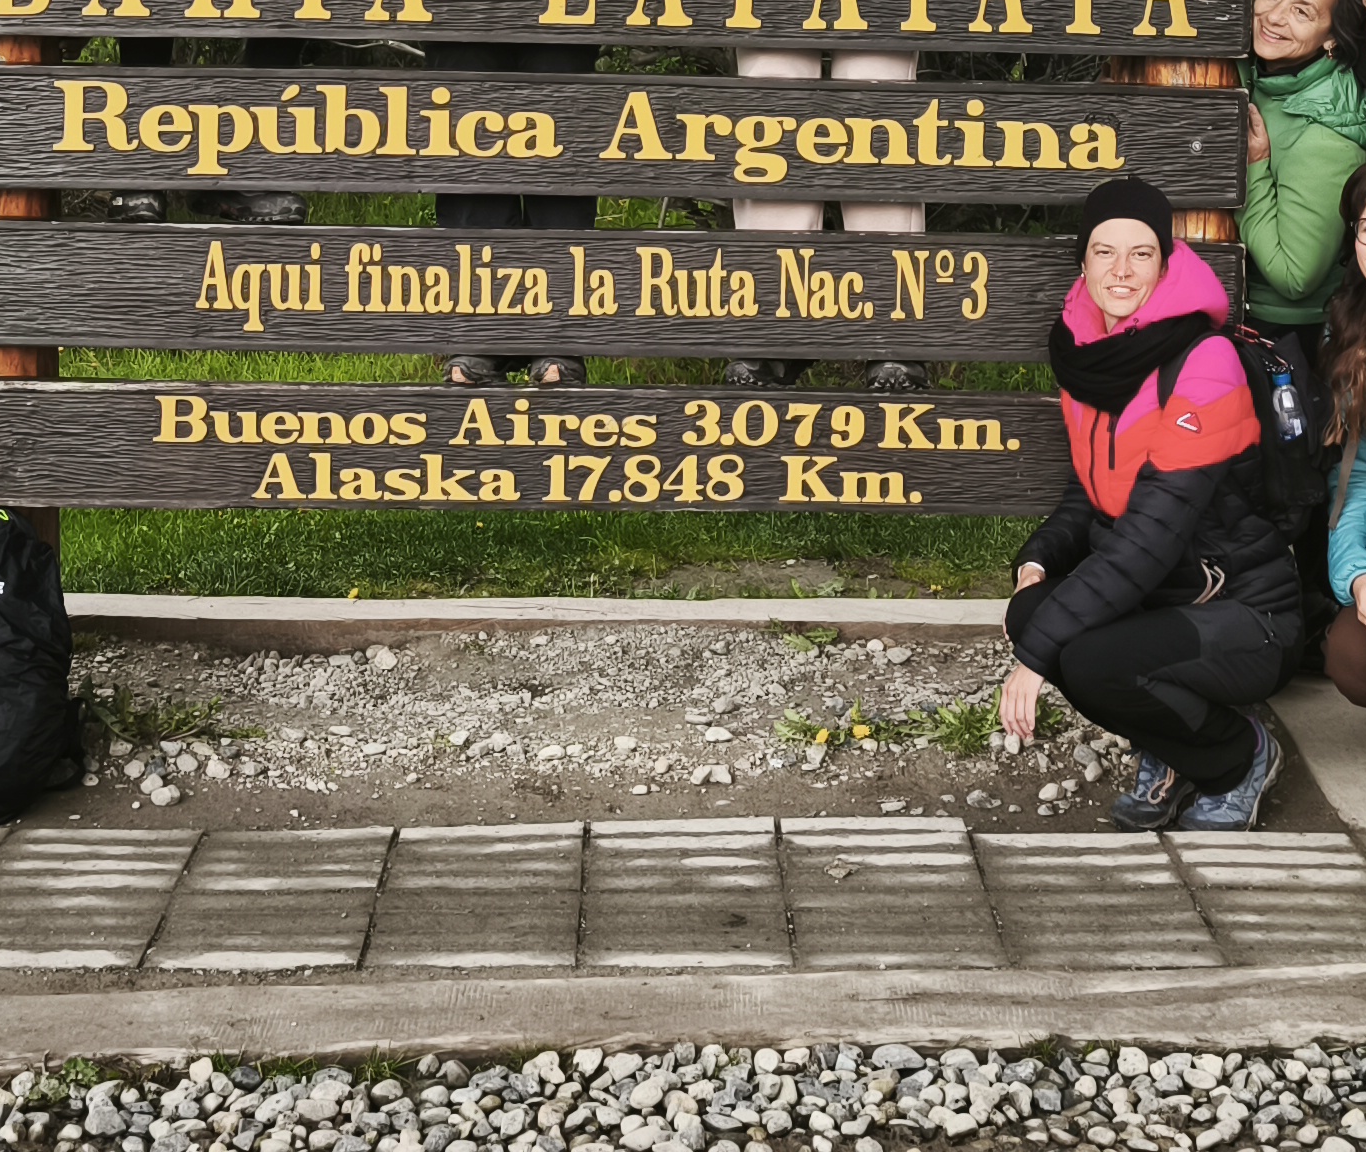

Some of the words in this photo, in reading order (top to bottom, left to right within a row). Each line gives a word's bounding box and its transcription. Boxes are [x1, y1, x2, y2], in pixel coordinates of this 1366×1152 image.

[53, 80, 564, 175] República
[599, 91, 1125, 183] Argentina
[195, 240, 324, 332] Aqui
[342, 243, 553, 315] finaliza
[569, 246, 619, 316] la
[636, 247, 759, 318] Ruta
[776, 249, 874, 320] Nac.
[153, 396, 428, 445] Buenos
[448, 399, 658, 447] Aires
[682, 401, 866, 448] 3.079
[877, 403, 1021, 451] Km.
[252, 453, 521, 502] Alaska
[542, 455, 746, 504] 17.848
[780, 456, 923, 506] Km.
